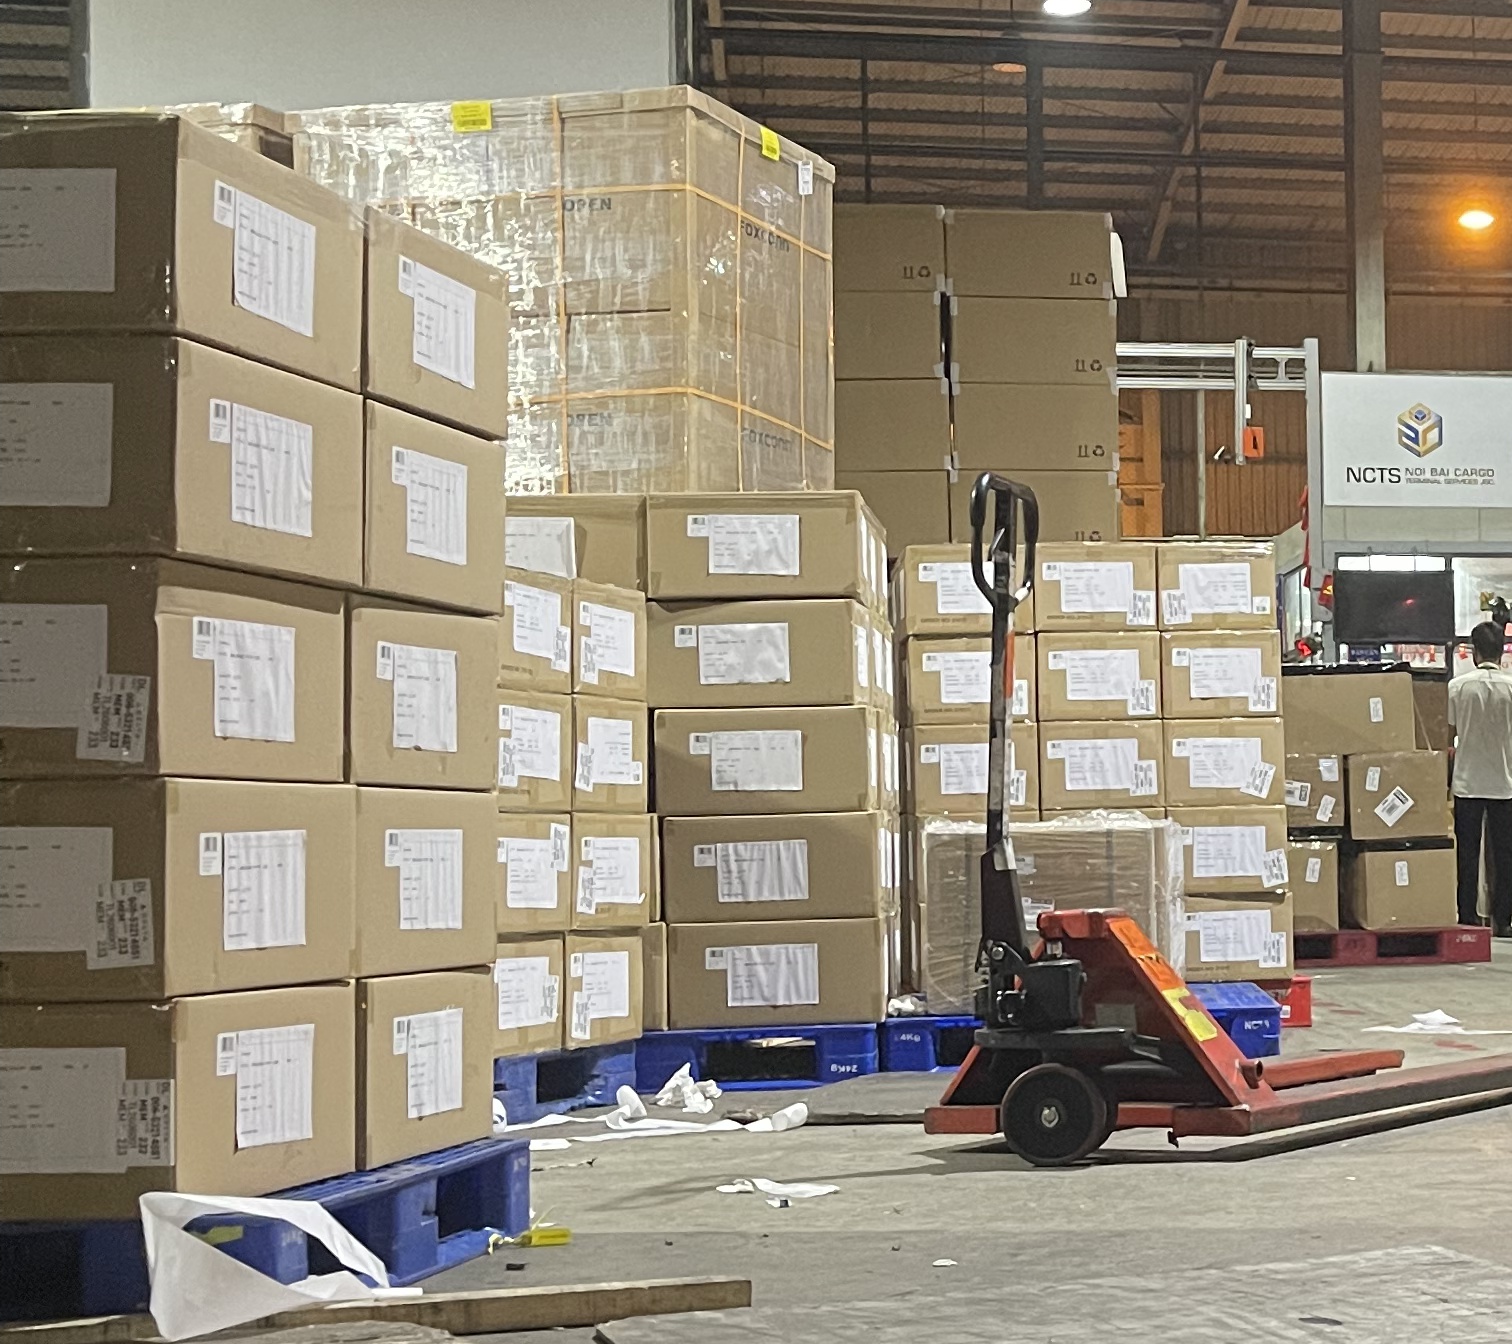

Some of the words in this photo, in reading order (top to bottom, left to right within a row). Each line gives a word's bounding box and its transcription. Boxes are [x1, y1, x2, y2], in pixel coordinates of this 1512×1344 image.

[1346, 467, 1400, 484] NCTS
[1405, 467, 1425, 477] NOI
[1430, 467, 1449, 477] BAI
[1454, 468, 1495, 478] CARGO
